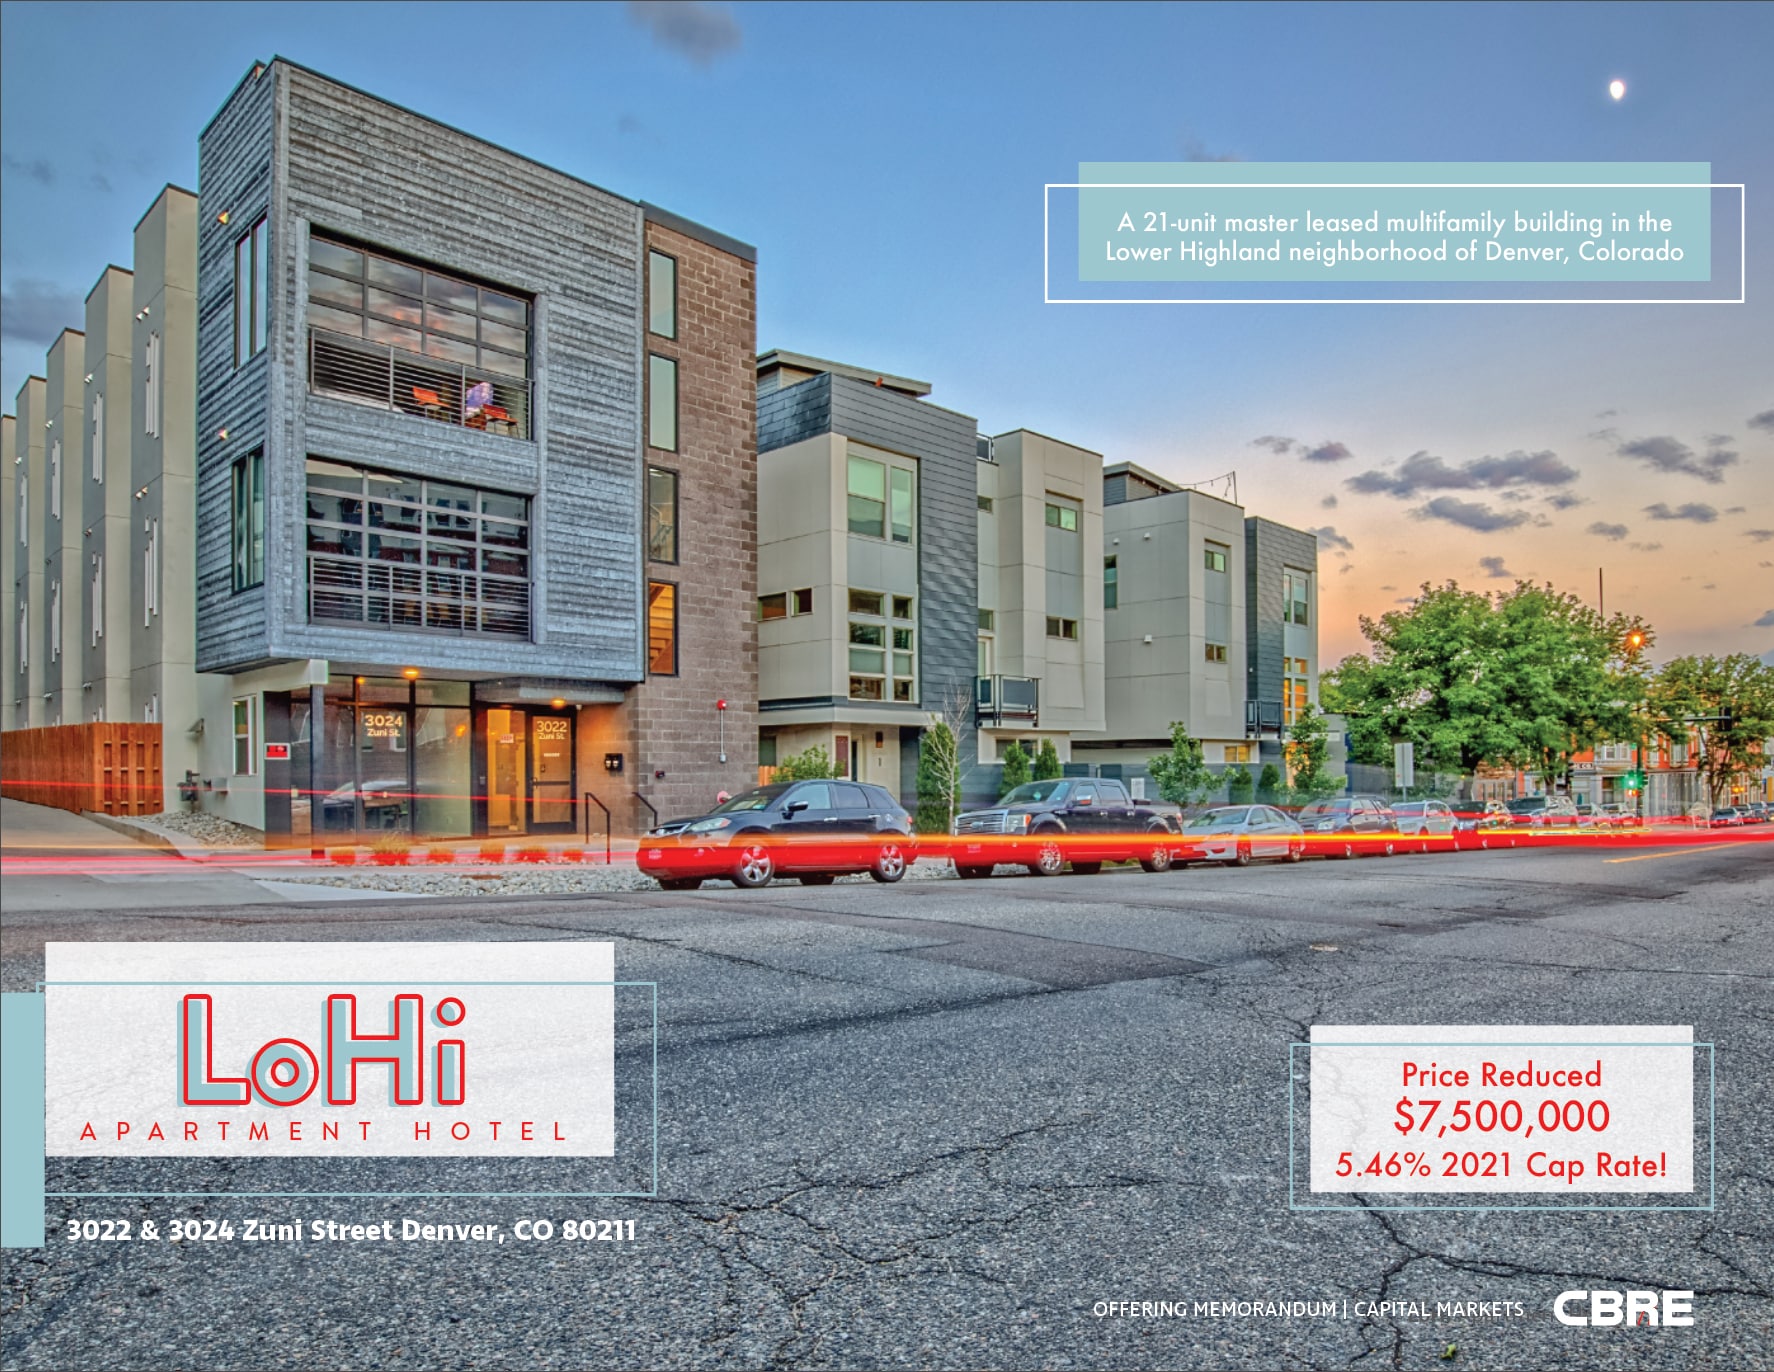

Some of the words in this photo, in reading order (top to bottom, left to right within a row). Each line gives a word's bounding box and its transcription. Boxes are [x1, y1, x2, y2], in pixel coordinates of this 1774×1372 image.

[364, 713, 403, 727] 3024
[536, 720, 567, 732] 3022
[366, 728, 387, 737] Zuni
[538, 732, 554, 740] Zuni
